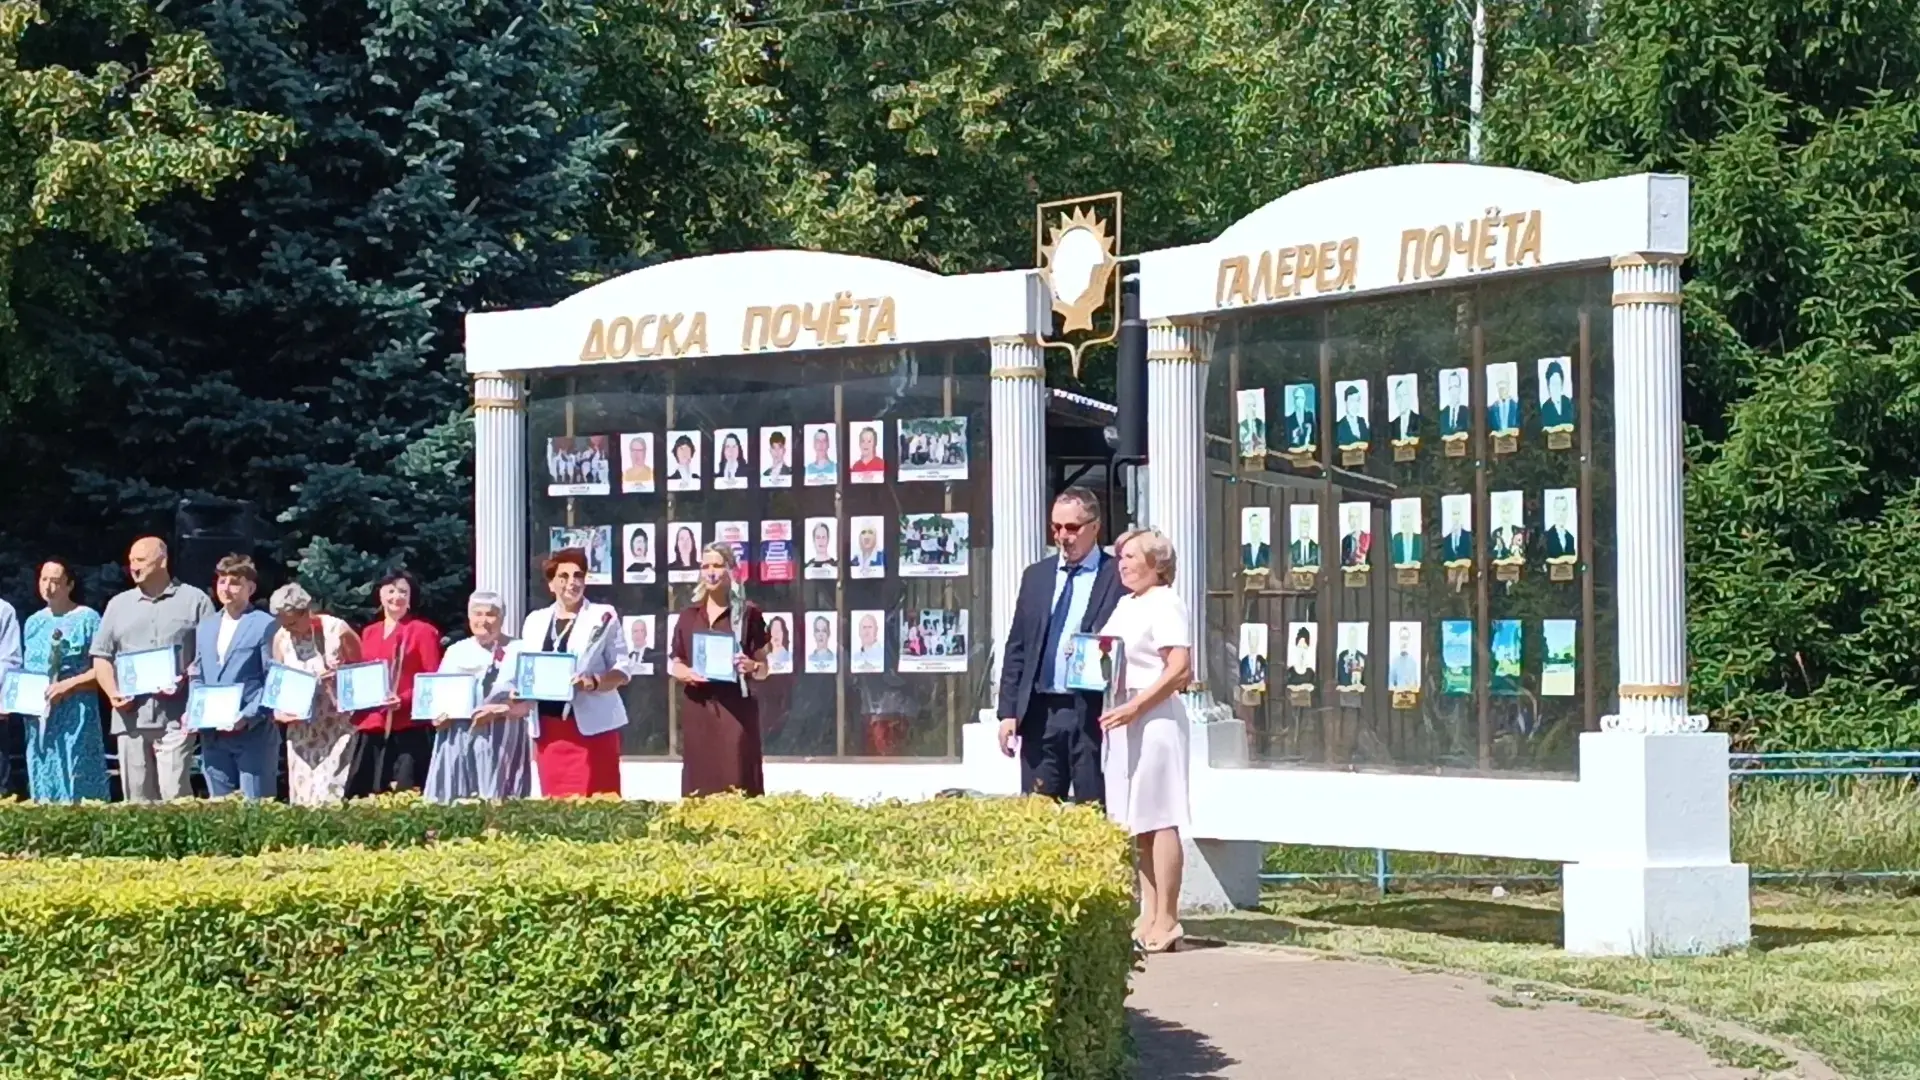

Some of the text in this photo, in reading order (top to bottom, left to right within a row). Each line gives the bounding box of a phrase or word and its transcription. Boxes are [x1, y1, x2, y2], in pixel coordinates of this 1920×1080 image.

[1216, 206, 1543, 307] ГАЛЕРЕЯ ПОЧЁТА
[579, 291, 896, 361] ДОСКА ПОЧЁТА
